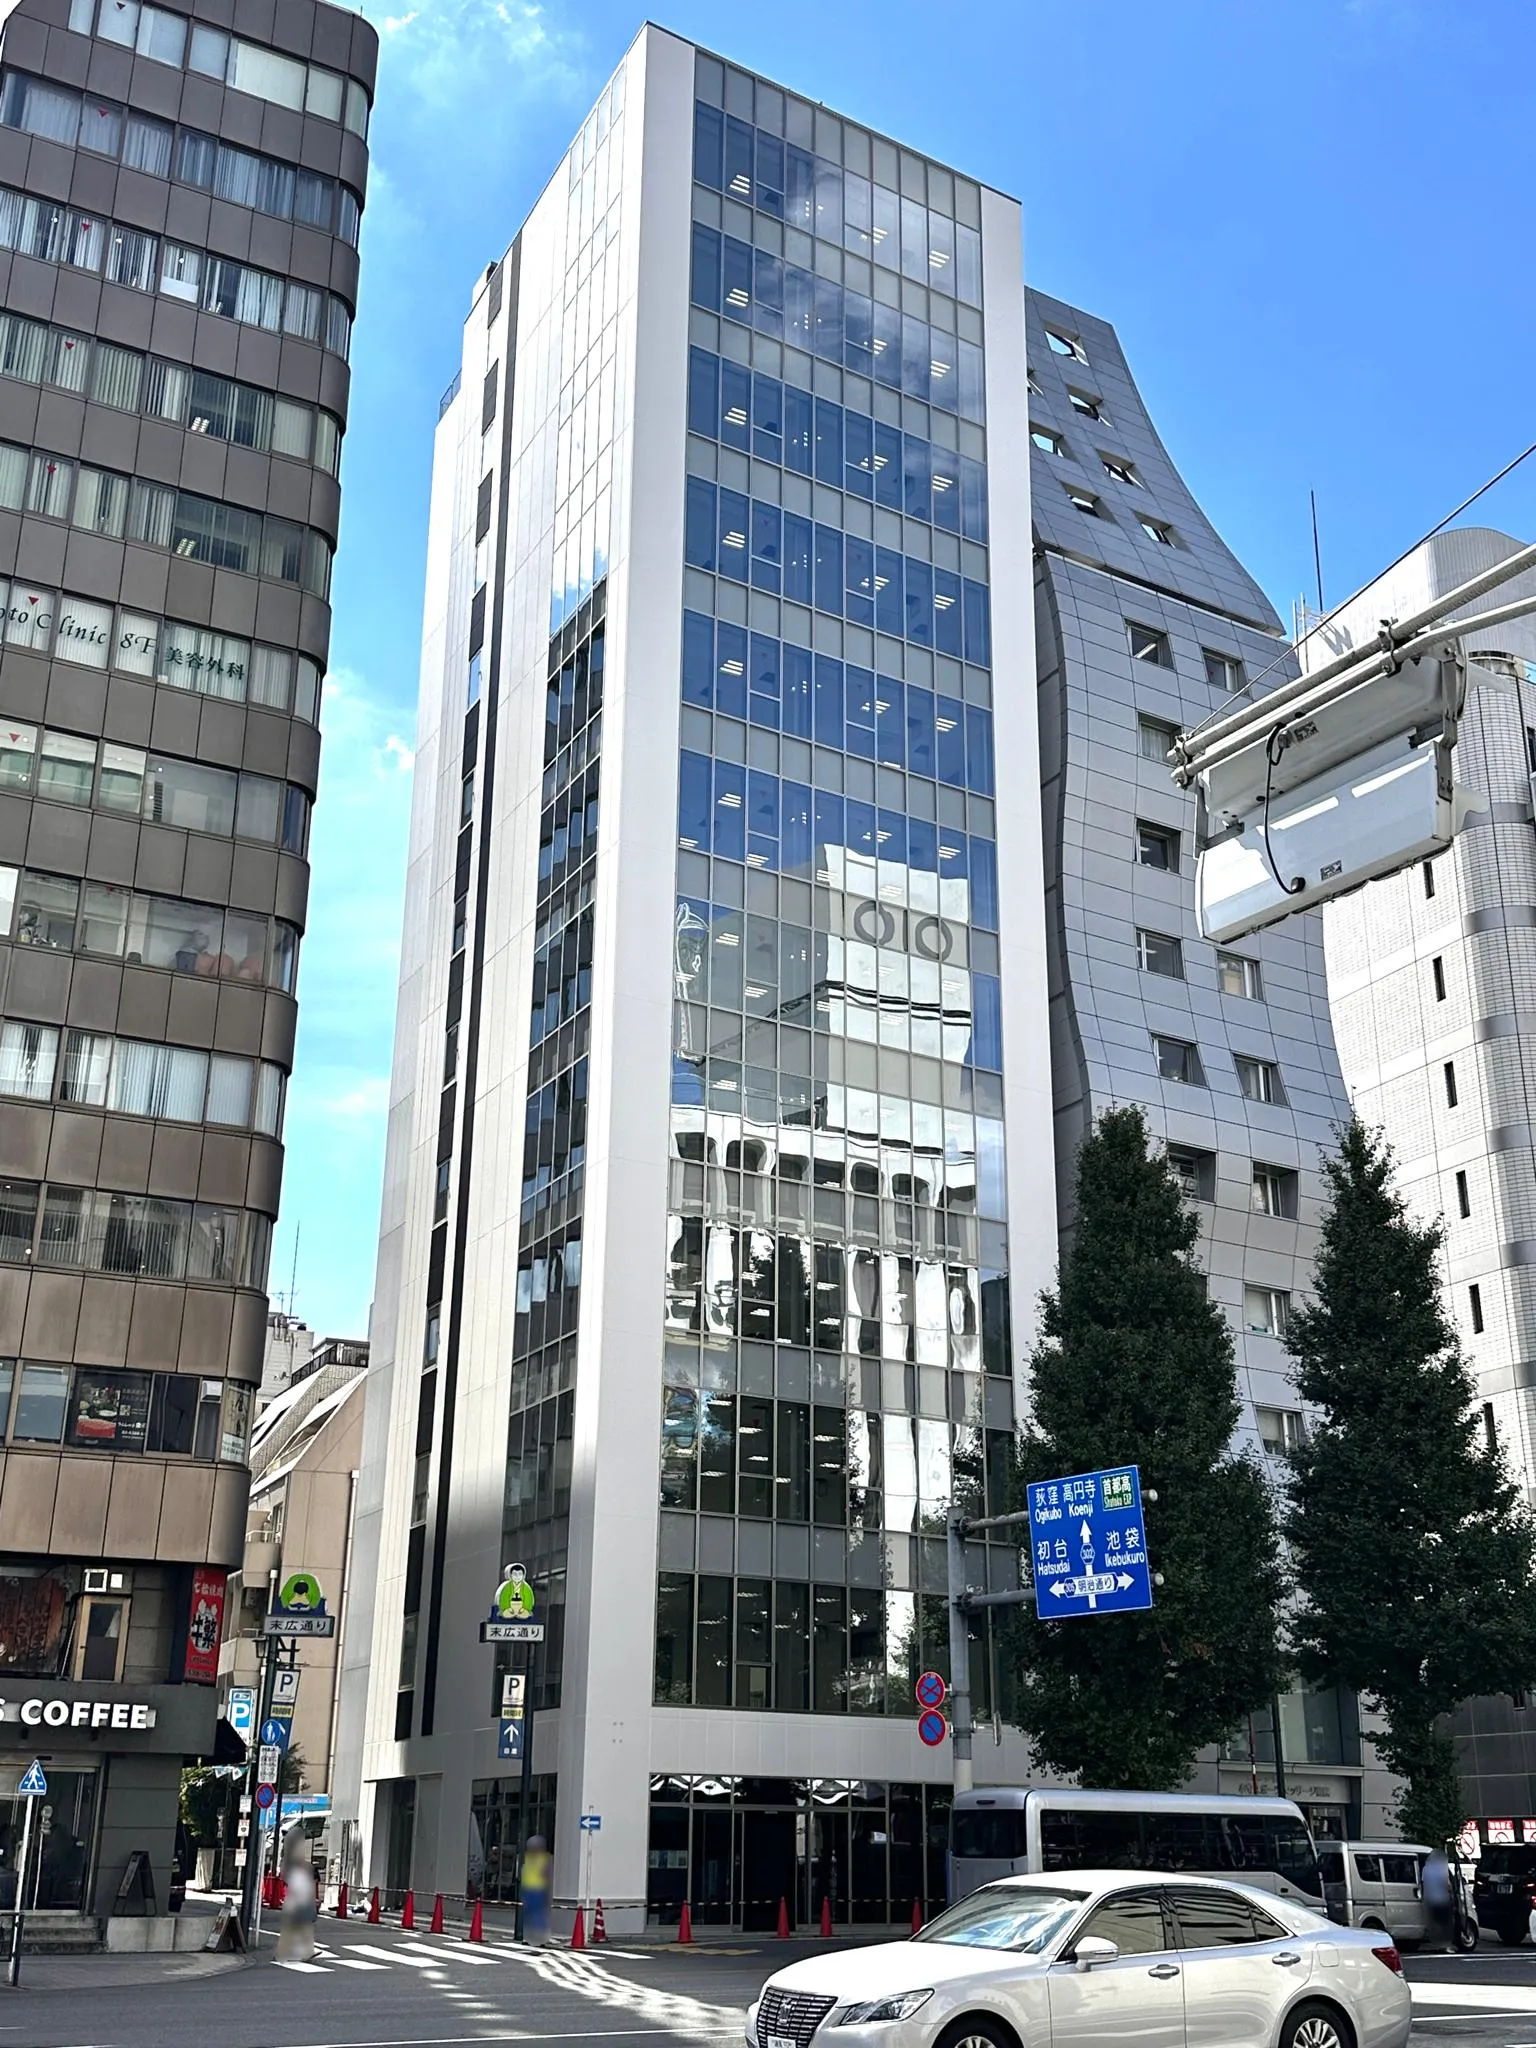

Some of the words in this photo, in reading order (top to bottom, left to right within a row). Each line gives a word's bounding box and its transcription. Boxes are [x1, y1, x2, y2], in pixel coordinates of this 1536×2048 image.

[165, 646, 244, 680] 美容外科
[1035, 1486, 1059, 1507] 荻窪
[1062, 1479, 1096, 1503] 高円寺
[1102, 1475, 1132, 1496] 首都高
[1035, 1507, 1062, 1524] Ogikubo
[1068, 1501, 1093, 1517] Koenji
[1037, 1538, 1067, 1560] 初台
[1106, 1527, 1140, 1551] 池袋
[1038, 1558, 1071, 1576] Hatsudai
[1104, 1551, 1145, 1568] Ikebukuro
[1078, 1577, 1112, 1593] 明治通り
[269, 1619, 327, 1632] 末広通り
[489, 1626, 540, 1638] 末広通り
[279, 1673, 294, 1693] P
[508, 1677, 520, 1695] P
[20, 1698, 149, 1729] COFFEE
[231, 1702, 250, 1728] P
